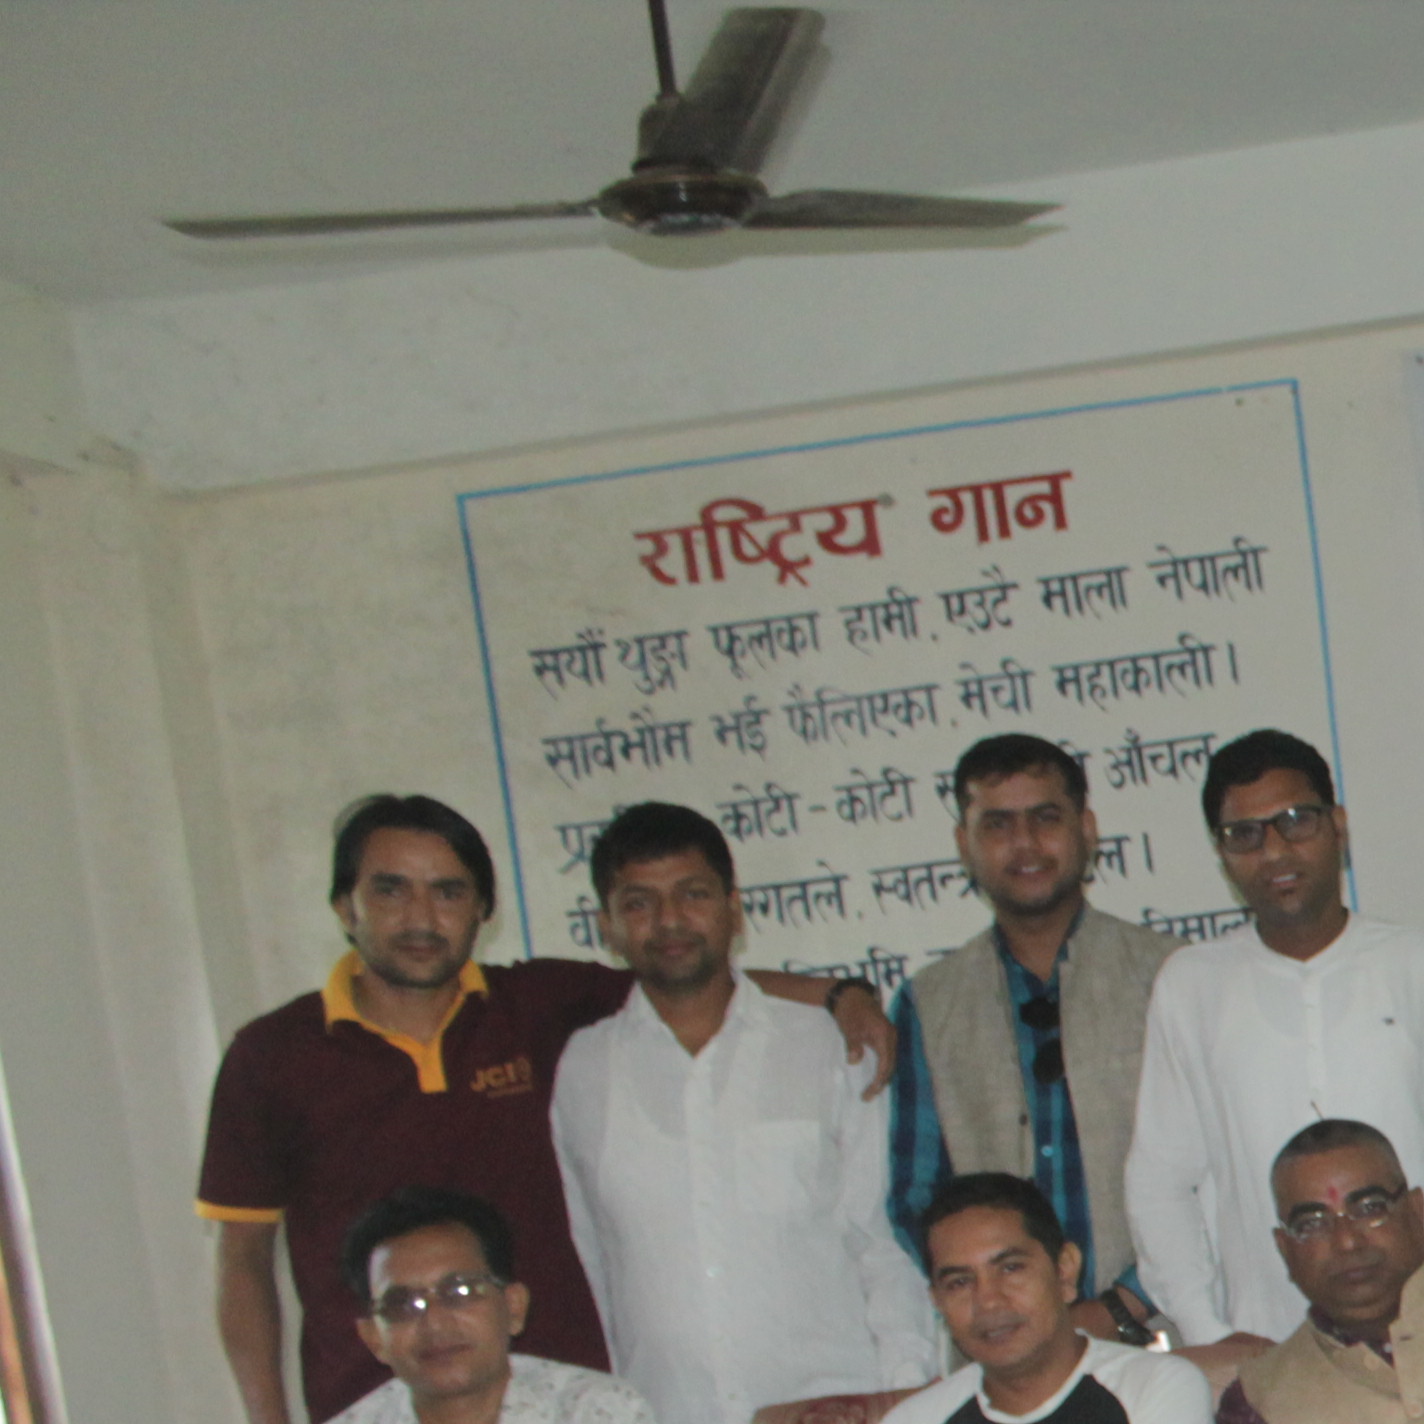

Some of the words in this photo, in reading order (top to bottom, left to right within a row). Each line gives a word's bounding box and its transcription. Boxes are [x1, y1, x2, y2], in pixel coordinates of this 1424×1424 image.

[633, 497, 883, 587] राष्ट्रिय
[927, 470, 1074, 545] गान
[705, 611, 820, 682] फूलका
[939, 564, 1020, 633] एउटै
[1036, 564, 1130, 619] माला
[1146, 536, 1269, 601] नेपाली
[541, 706, 693, 789] सार्वभौम
[709, 696, 770, 762] भई
[955, 656, 1036, 720] मेची
[469, 1062, 516, 1093] JCI
